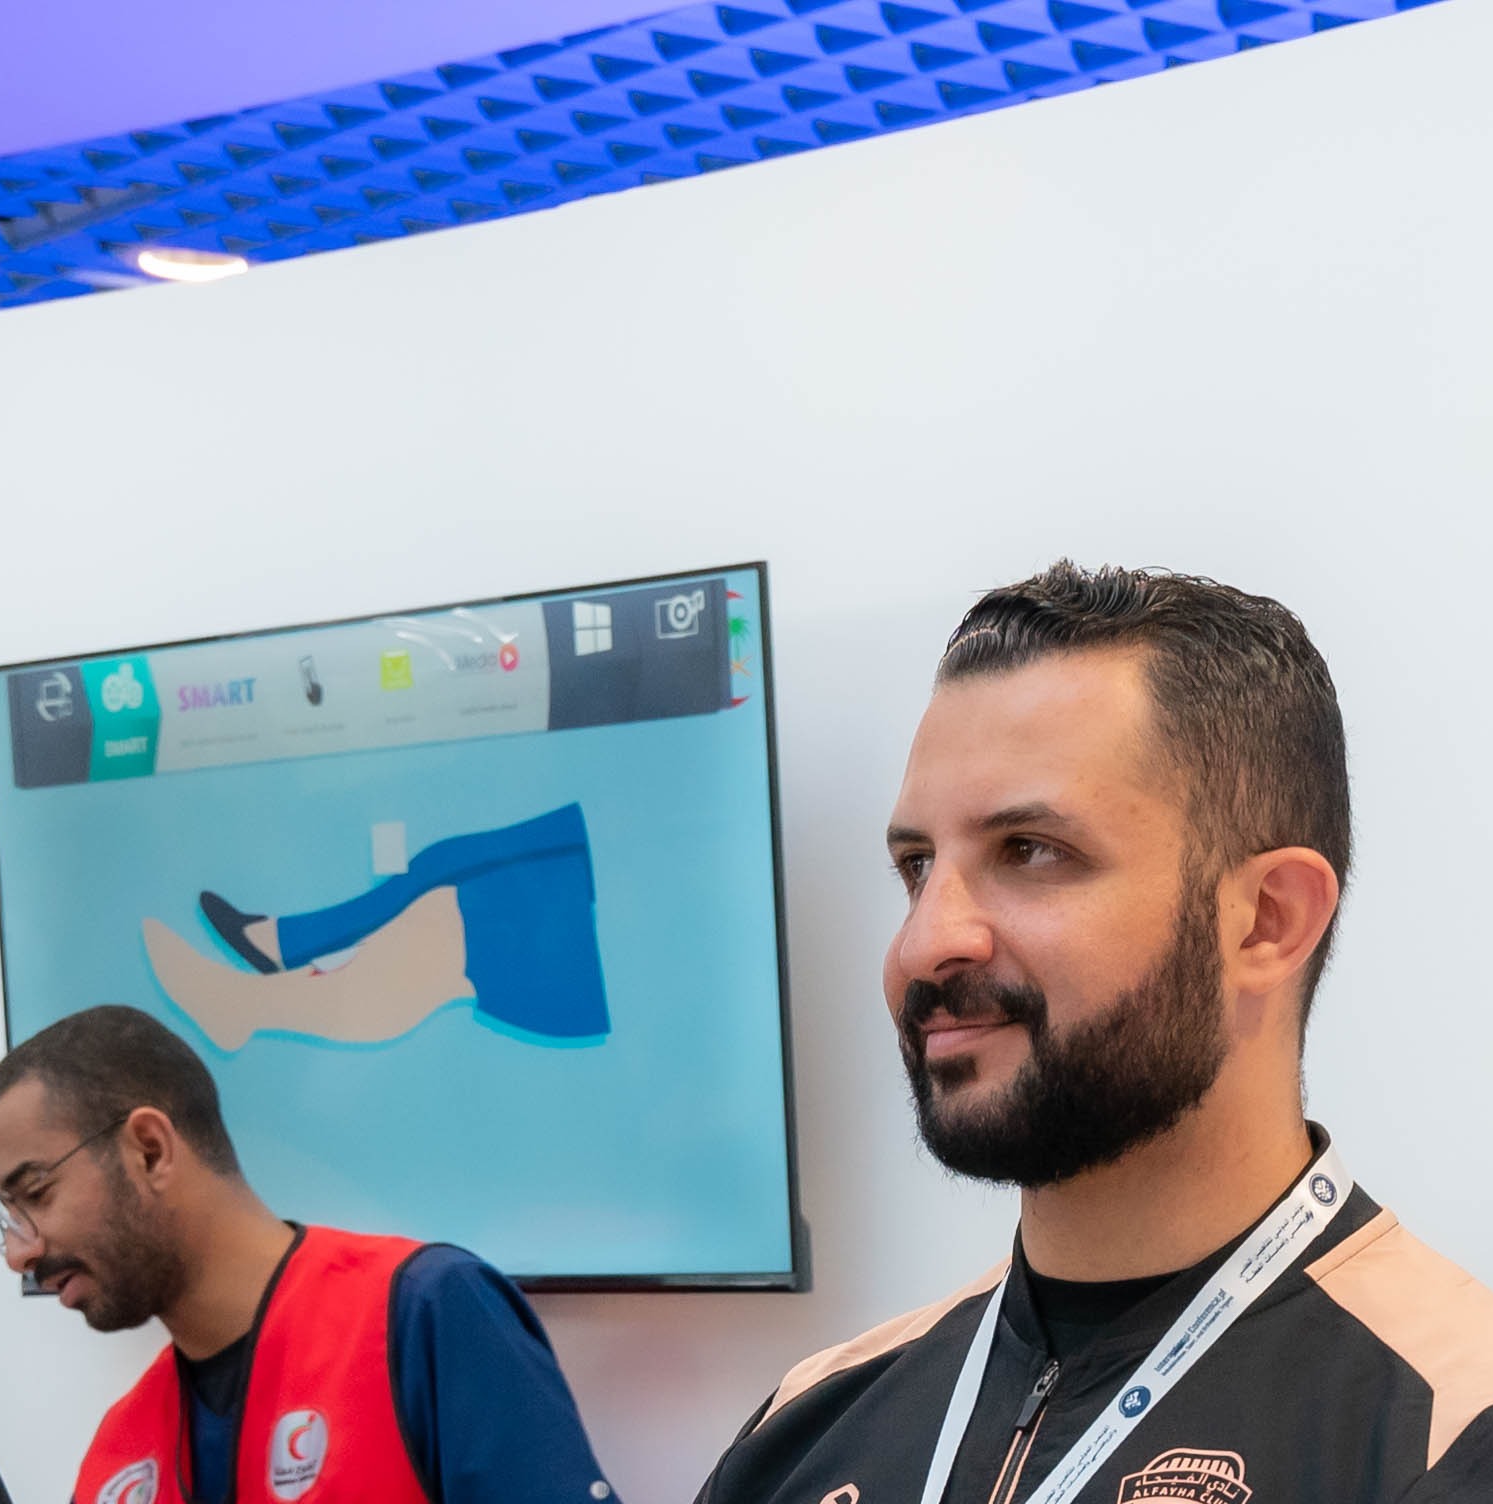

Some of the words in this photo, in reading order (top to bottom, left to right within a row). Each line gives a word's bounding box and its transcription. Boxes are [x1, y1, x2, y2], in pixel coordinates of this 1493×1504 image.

[176, 676, 258, 713] SMART
[1135, 1472, 1209, 1487] الفيحاء
[1132, 1486, 1196, 1499] ALFAYHA
[1206, 1480, 1241, 1499] نادي
